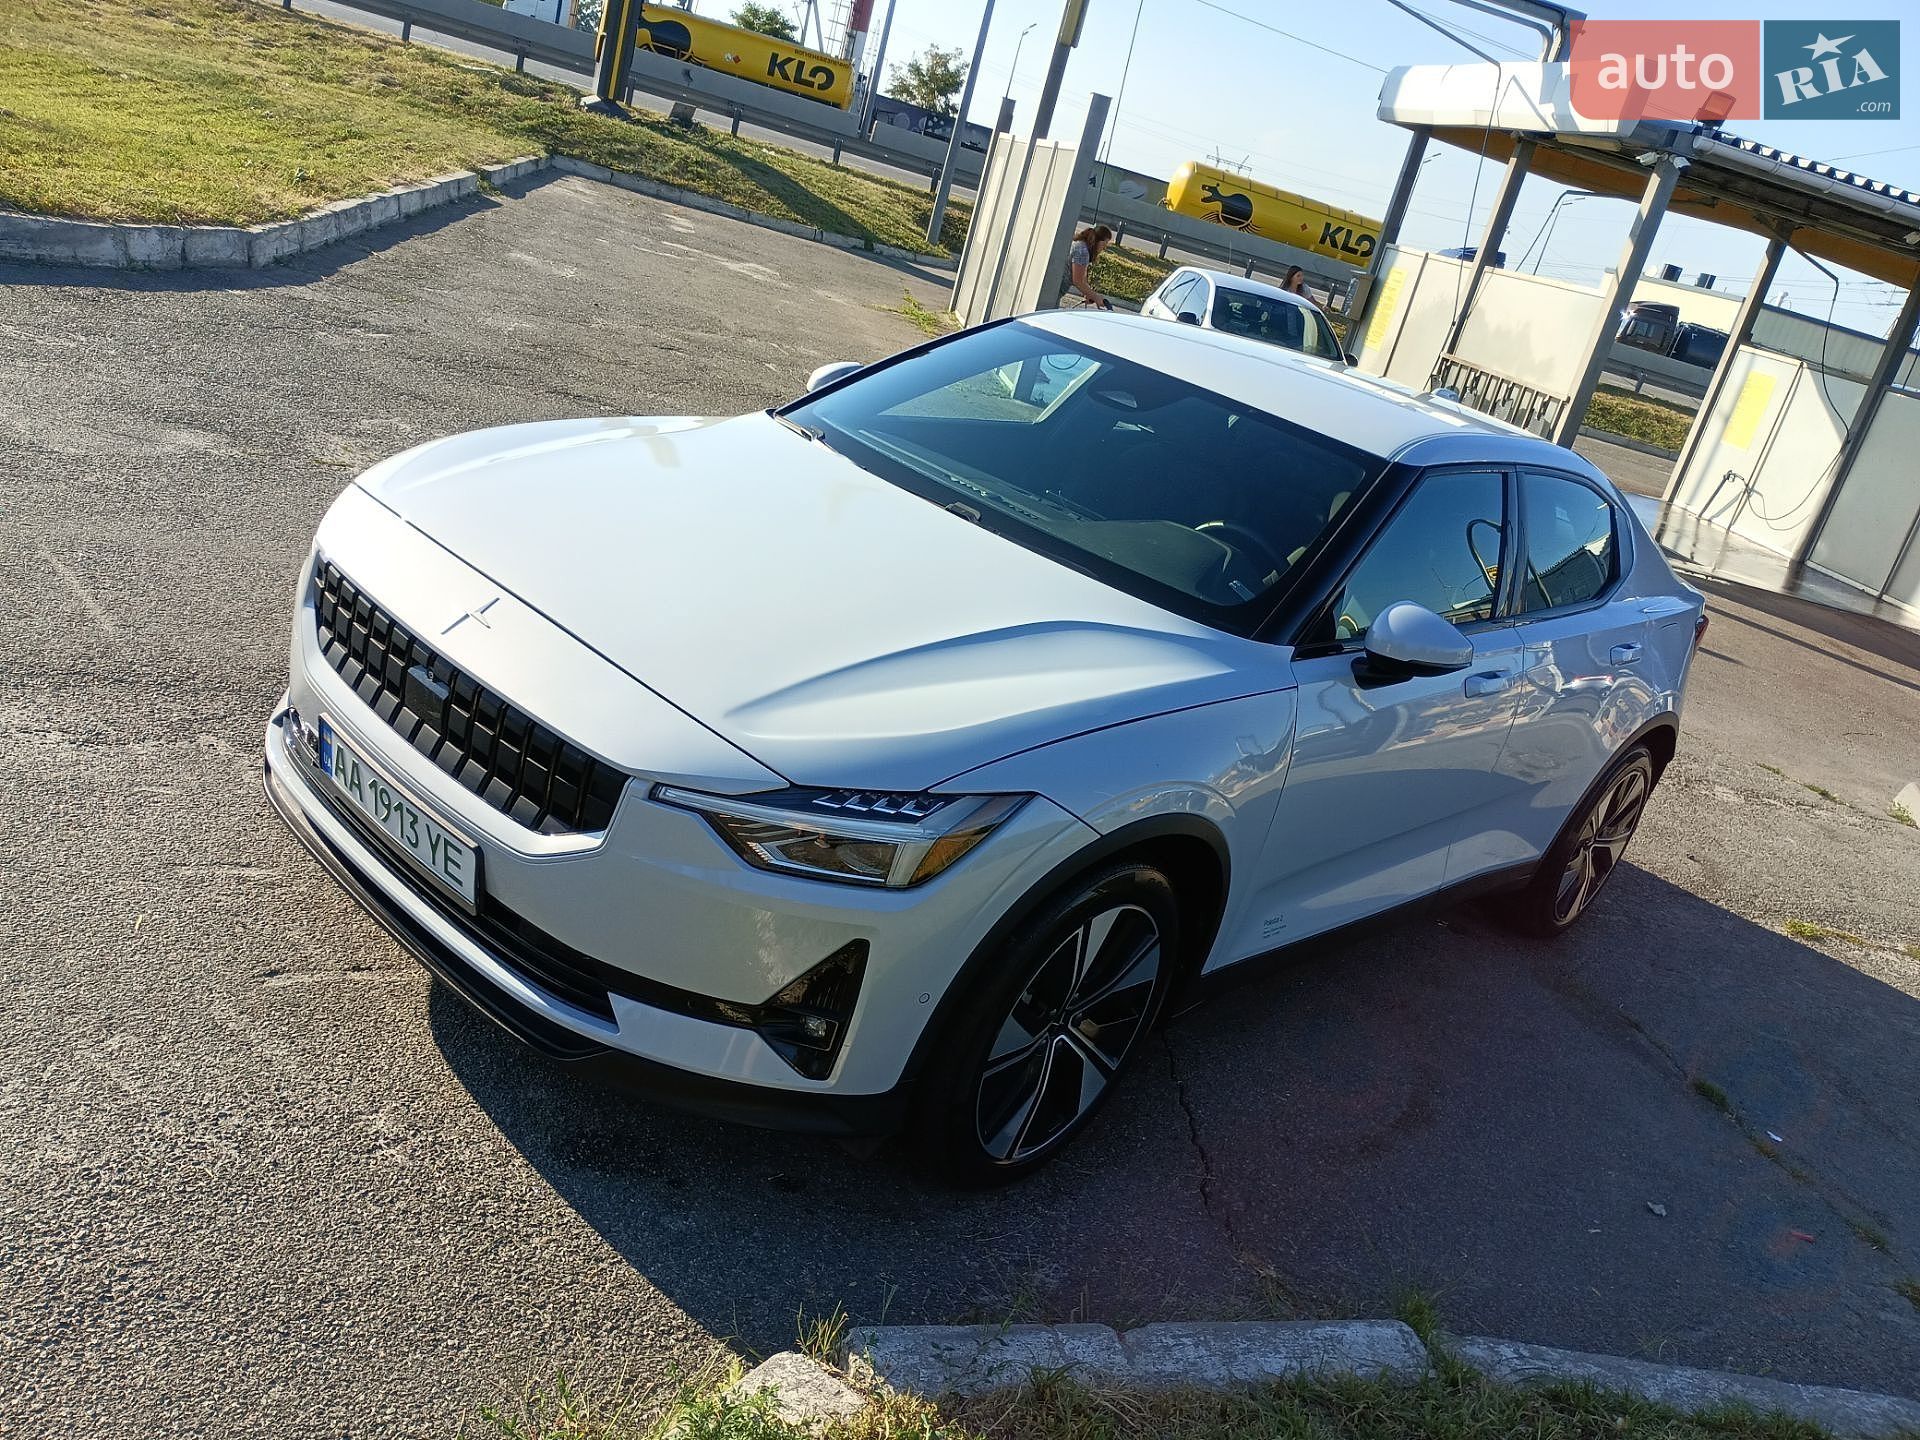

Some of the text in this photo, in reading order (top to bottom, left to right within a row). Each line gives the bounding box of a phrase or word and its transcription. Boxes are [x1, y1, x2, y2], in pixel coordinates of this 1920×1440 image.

[767, 51, 835, 91] KLO
[1319, 221, 1377, 258] KLO
[322, 753, 332, 769] UA
[334, 742, 463, 888] AA 1913 YE
